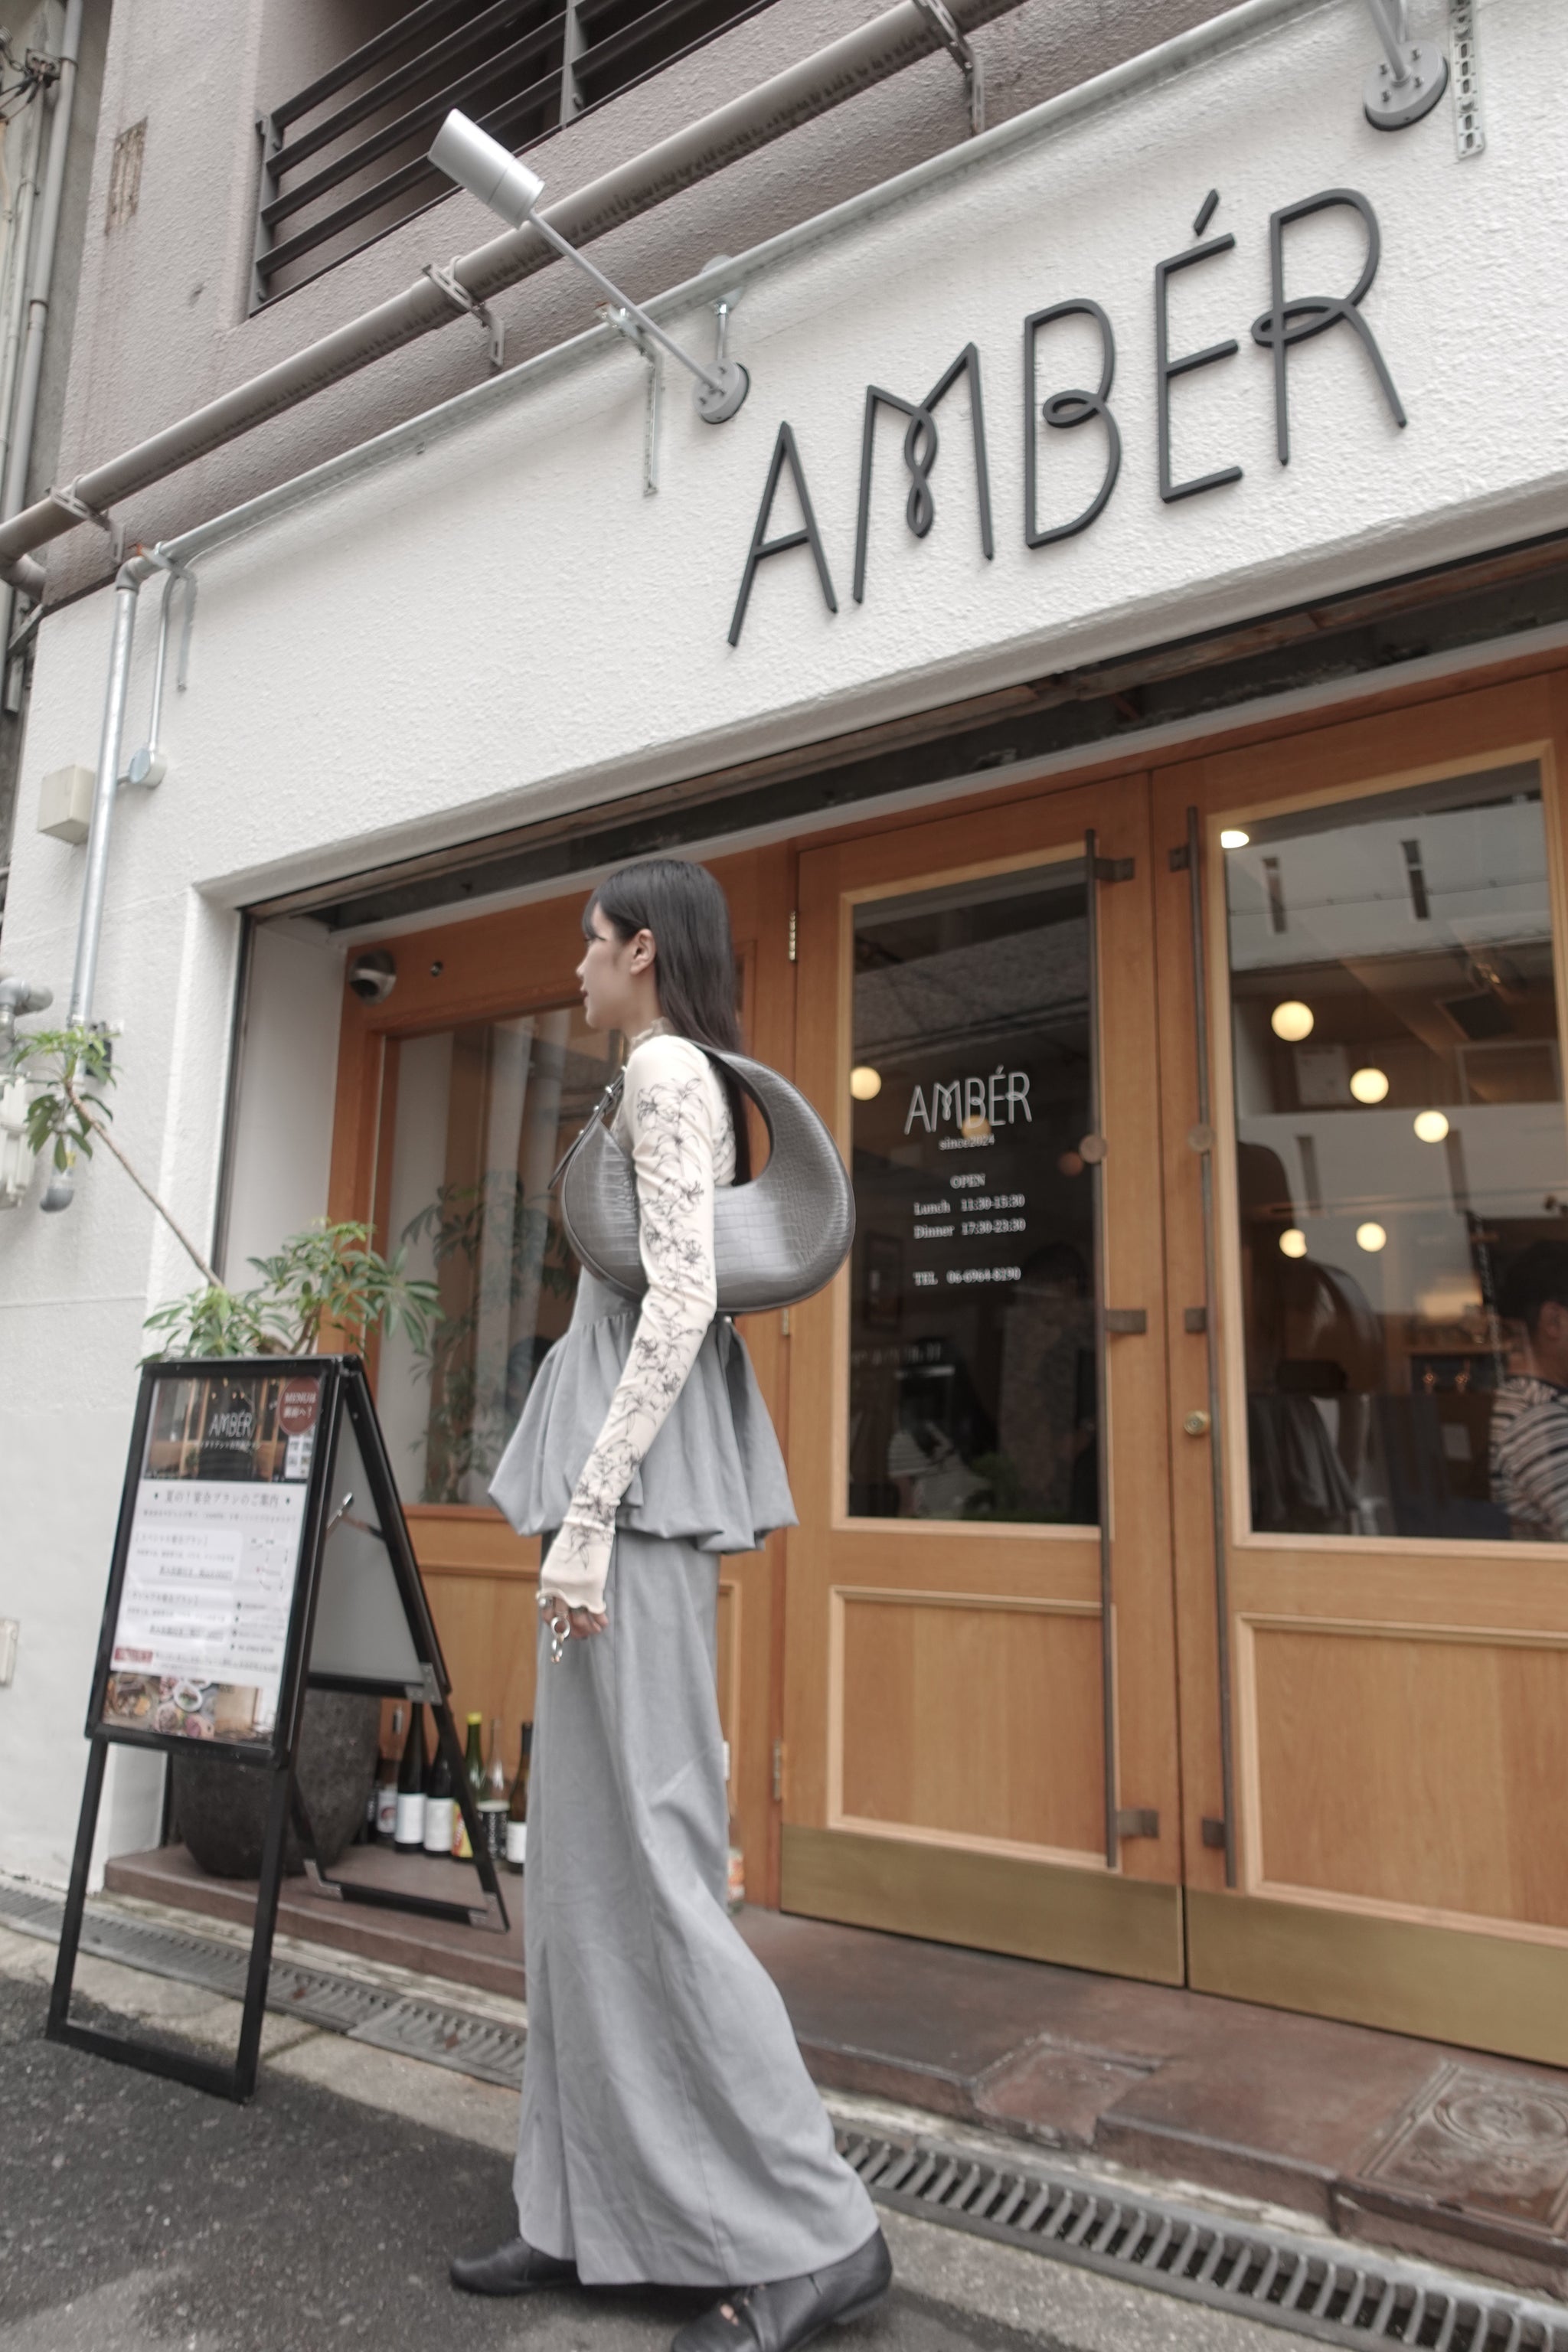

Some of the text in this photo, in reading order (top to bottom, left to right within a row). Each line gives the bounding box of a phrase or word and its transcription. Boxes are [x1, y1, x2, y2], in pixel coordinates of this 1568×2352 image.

[729, 188, 1406, 647] AMBÉR
[904, 1065, 1032, 1135] AMBÉR
[949, 1174, 985, 1188] OPEN
[913, 1200, 951, 1216] Lunch
[913, 1225, 955, 1239] Dinner
[913, 1271, 938, 1286] TEL
